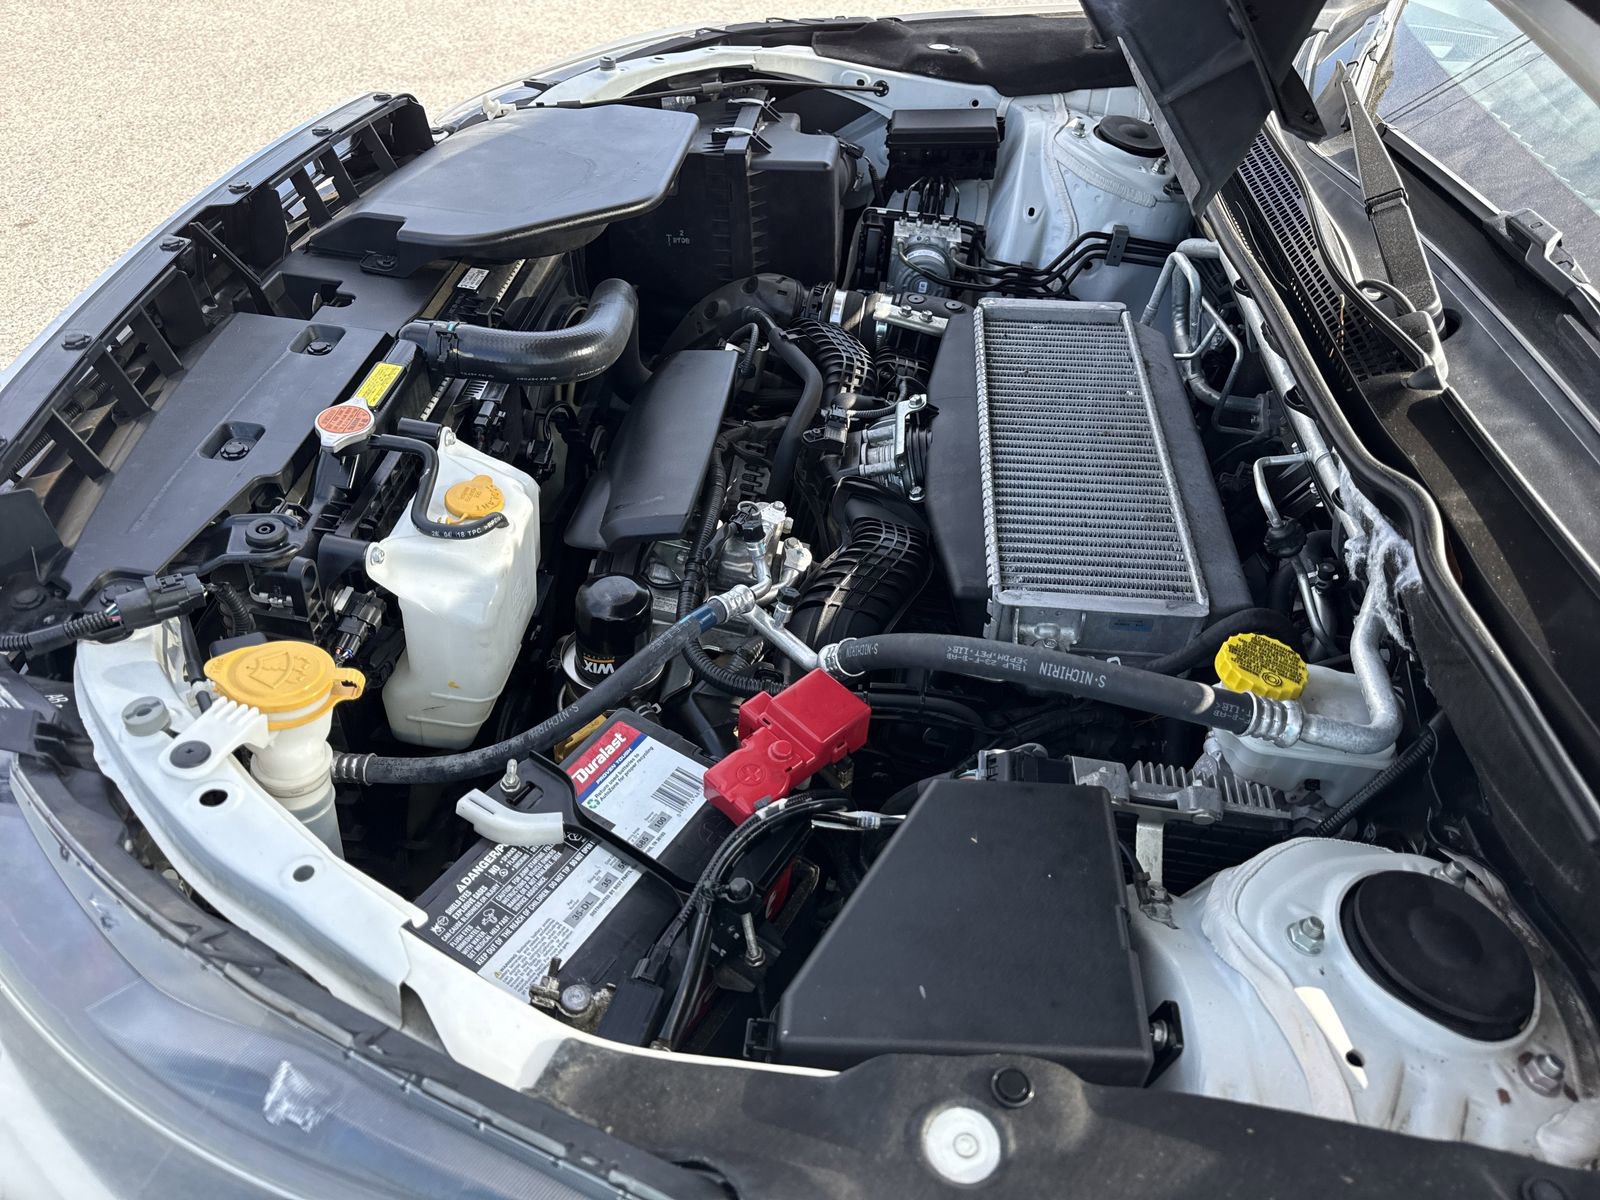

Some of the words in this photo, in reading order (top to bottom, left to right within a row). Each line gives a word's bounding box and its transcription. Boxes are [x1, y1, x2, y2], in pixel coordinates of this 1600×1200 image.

[584, 660, 614, 674] WIX
[571, 732, 627, 785] Duralast
[594, 763, 618, 784] PROVEN
[614, 747, 633, 764] TOUGH
[593, 783, 610, 798] Return
[607, 774, 619, 784] used
[616, 757, 636, 774] batteries
[598, 781, 620, 801] AutoZone
[622, 762, 639, 777] proper
[634, 745, 655, 763] recycling
[653, 816, 667, 828] 100
[501, 846, 517, 862] SPARKS
[506, 850, 523, 866] FLAMES
[488, 864, 500, 875] NO
[511, 875, 522, 885] FOR
[600, 877, 612, 887] 35
[444, 898, 462, 915] SHIELD
[458, 889, 472, 901] EYES
[452, 896, 475, 920] EXPLOSIVE
[472, 884, 488, 899] GASES
[475, 952, 489, 965] KEEP
[485, 943, 498, 954] OUT
[494, 936, 504, 945] OF
[500, 928, 512, 938] THE
[508, 914, 526, 930] REACH
[522, 908, 531, 916] OF
[548, 880, 558, 889] DO
[554, 872, 565, 882] NOT
[574, 852, 585, 861] NOT
[506, 892, 523, 908] MANUAL
[511, 896, 528, 912] SERVICE
[570, 898, 594, 920] 35-DL
[440, 931, 451, 941] CAN
[448, 920, 463, 934] CAUSE
[459, 900, 482, 922] BLINDNESS
[484, 882, 500, 897] INJURY
[449, 933, 464, 947] FLUSH
[461, 924, 473, 935] EYES
[455, 925, 482, 951] IMMEDIATELY
[466, 949, 477, 959] GET
[473, 933, 492, 951] MEDICAL
[489, 924, 501, 936] HELP
[461, 943, 474, 955] WITH
